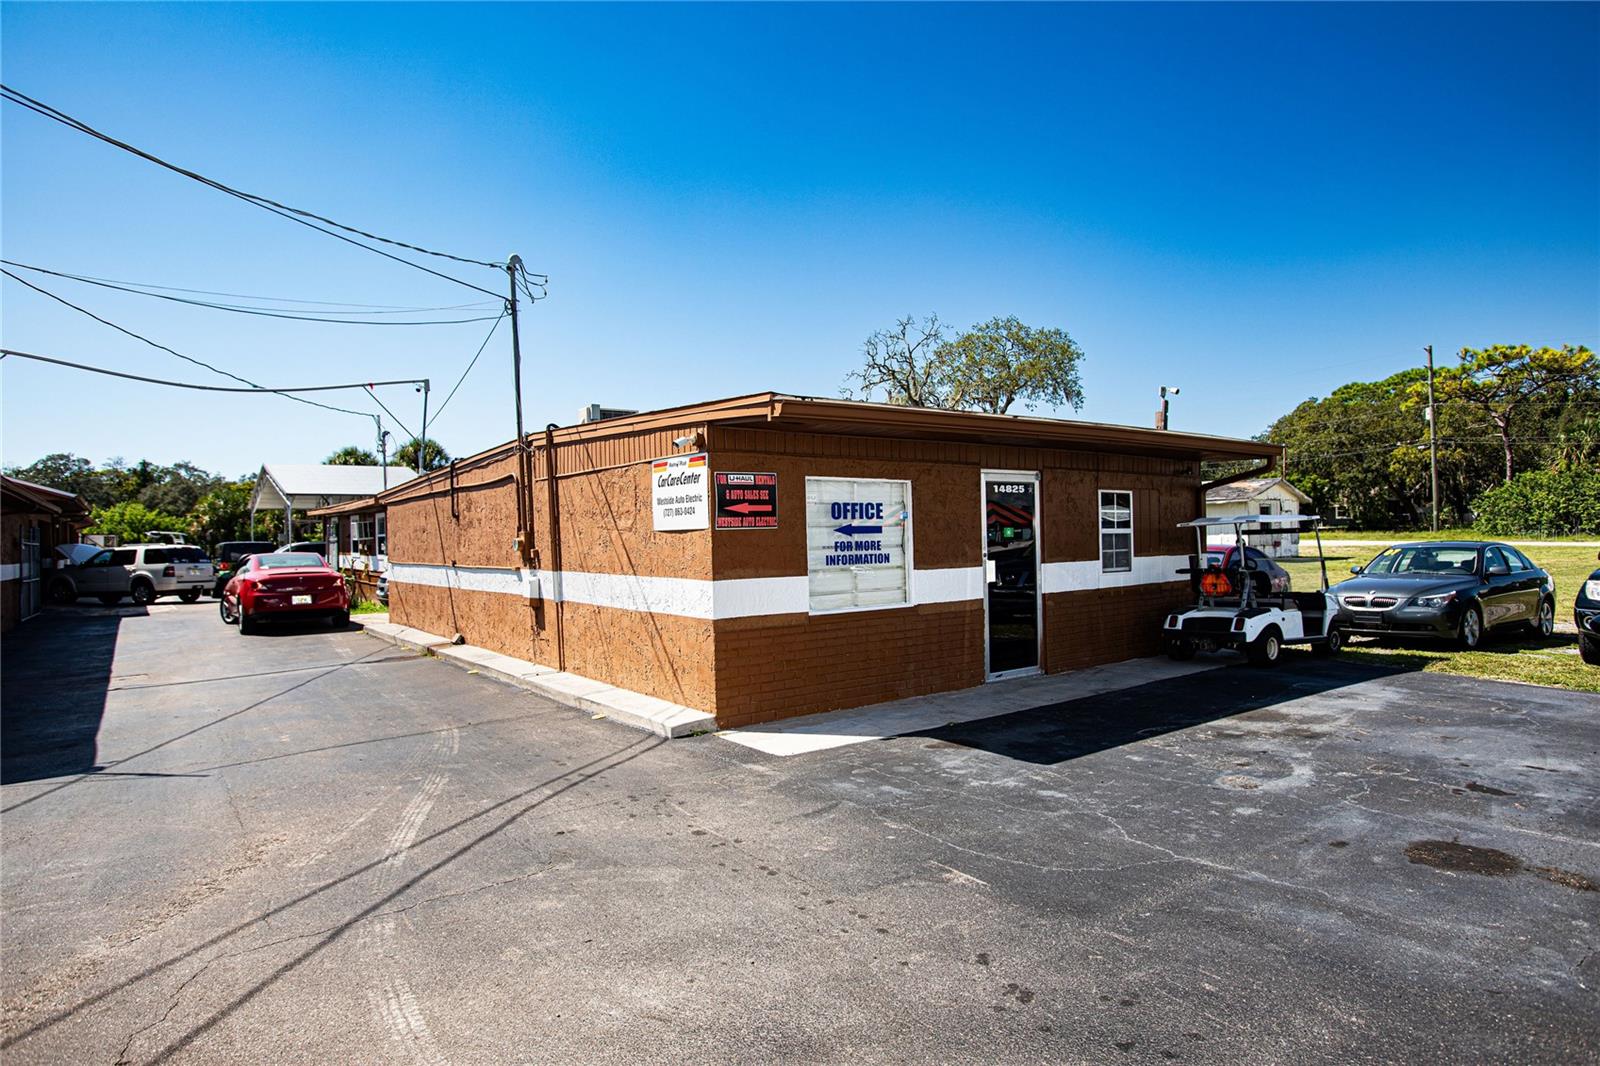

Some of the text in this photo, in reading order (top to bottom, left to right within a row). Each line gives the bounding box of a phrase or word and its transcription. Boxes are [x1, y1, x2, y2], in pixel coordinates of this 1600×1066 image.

[658, 472, 701, 487] CarCareCenter
[993, 484, 1025, 493] 14825
[675, 495, 685, 504] Auto
[685, 494, 703, 503] Electric
[730, 490, 743, 500] AUTO
[744, 490, 759, 500] SALES
[831, 502, 884, 520] OFFICE
[743, 517, 755, 527] AUTO
[834, 540, 882, 552] FOR MORE
[825, 553, 890, 566] INFORMATION
